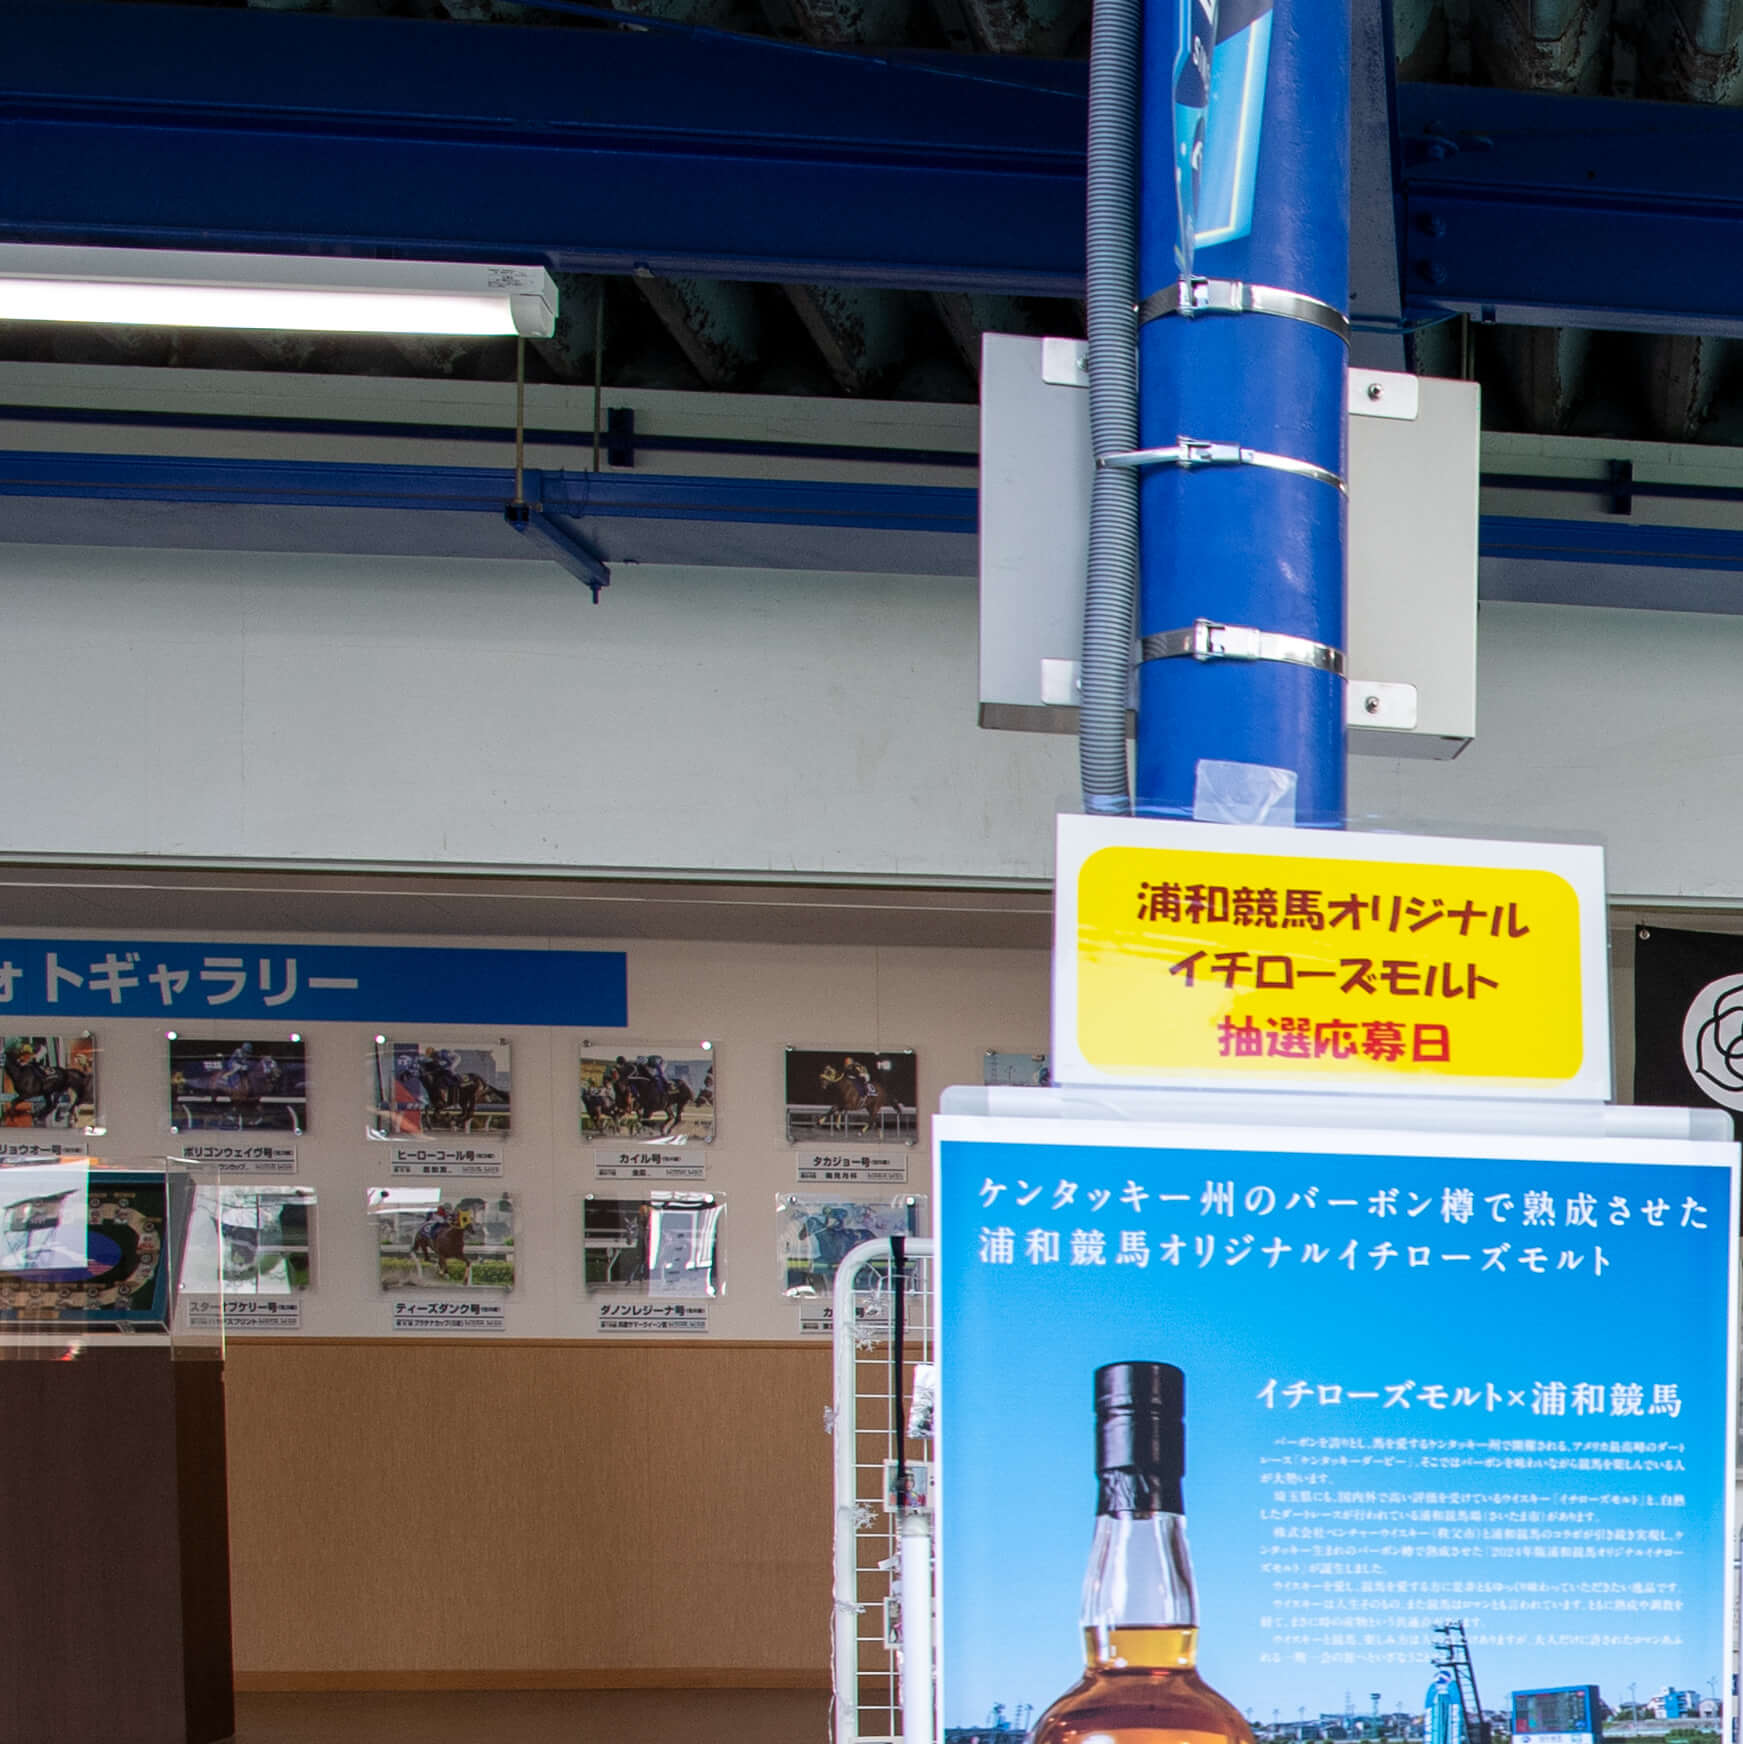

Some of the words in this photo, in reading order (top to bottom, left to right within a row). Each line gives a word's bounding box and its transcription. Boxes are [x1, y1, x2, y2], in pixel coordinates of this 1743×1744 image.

[1137, 881, 1531, 939] 浦和競馬オリジナル
[1169, 951, 1499, 999] イチローズモルト
[1217, 1015, 1452, 1063] 抽選応募日
[397, 1151, 475, 1162] ヒーローコール号
[619, 1153, 662, 1165] カイル号
[813, 1156, 870, 1168] タカジョー号
[978, 1176, 1710, 1231] ケンタッキー州のバーボン樽で熟成させた
[978, 1229, 1612, 1277] 浦和競馬オリジナルイチローズモルト
[396, 1303, 480, 1315] ティーズダンク号
[601, 1304, 685, 1317] ダノンレジーナ号
[1257, 1377, 1684, 1420] イチローズモルト×浦和競馬
